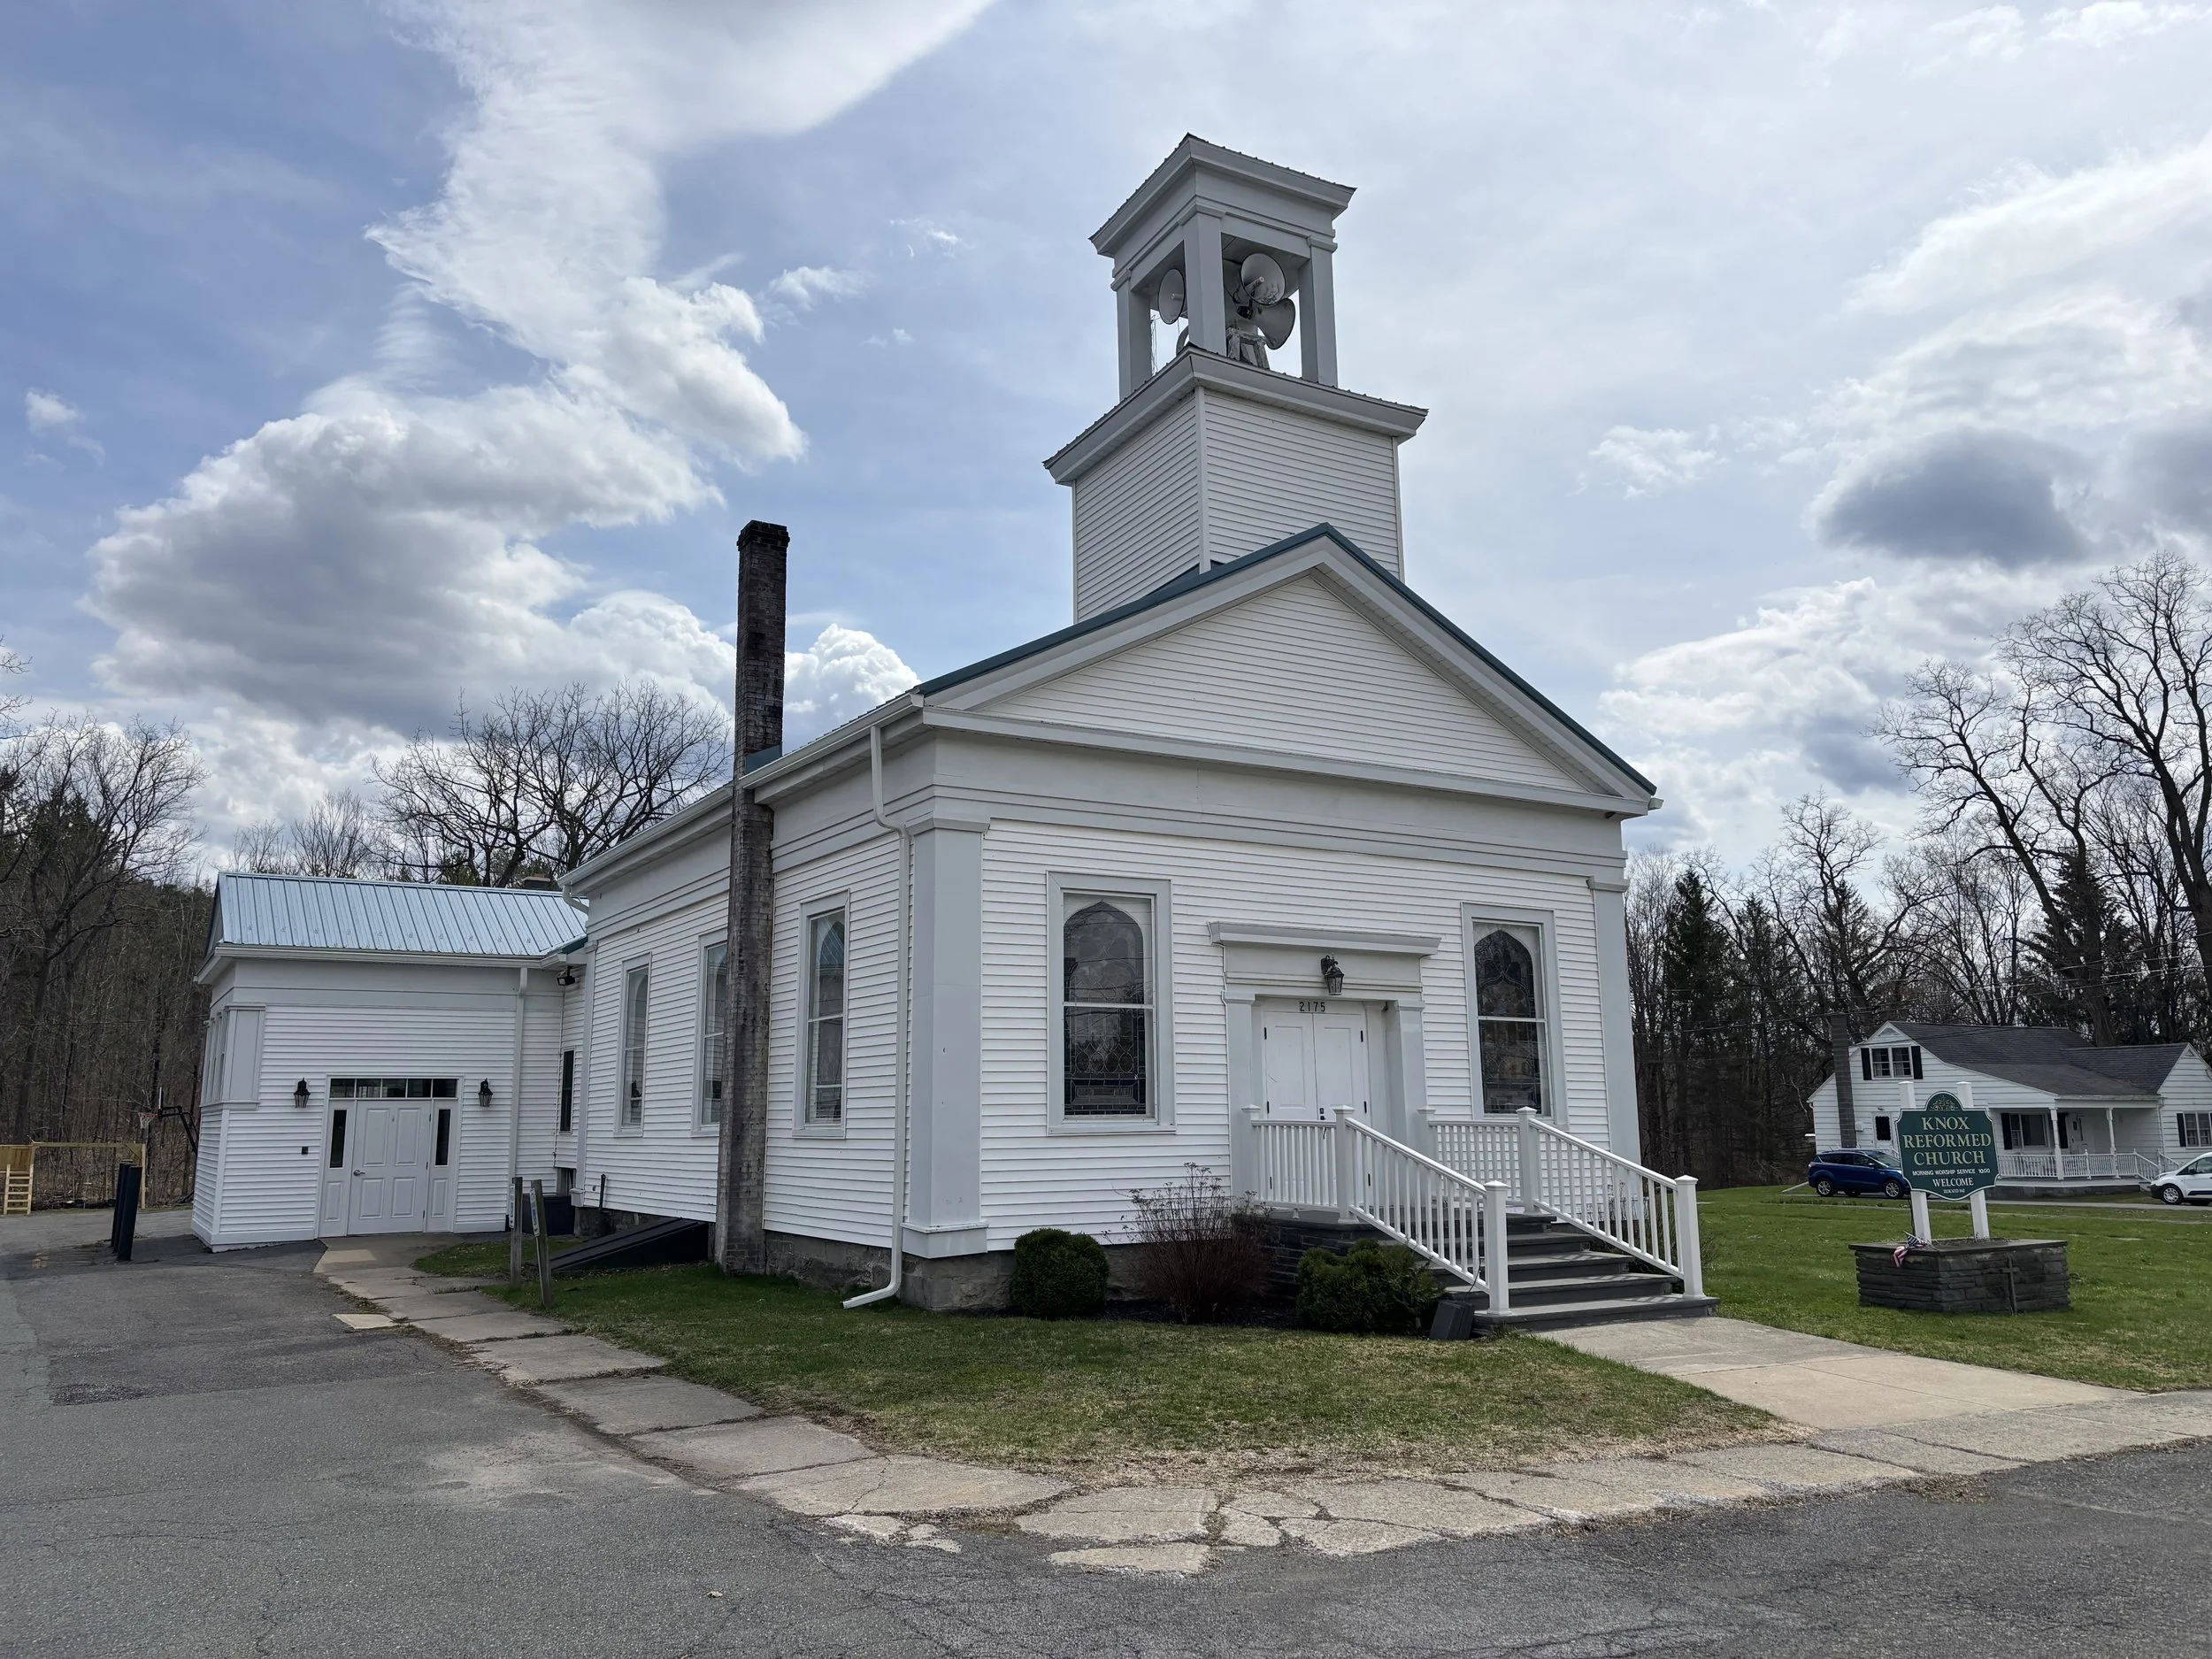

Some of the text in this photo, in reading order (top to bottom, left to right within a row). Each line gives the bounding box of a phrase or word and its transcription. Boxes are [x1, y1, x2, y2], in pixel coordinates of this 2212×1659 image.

[1300, 1002, 1325, 1012] 2175
[1921, 1117, 1970, 1131] KNOX
[1903, 1133, 1991, 1148] REFORMED
[1913, 1150, 1985, 1166] CHURCH
[1932, 1177, 1974, 1187] WELCOME
